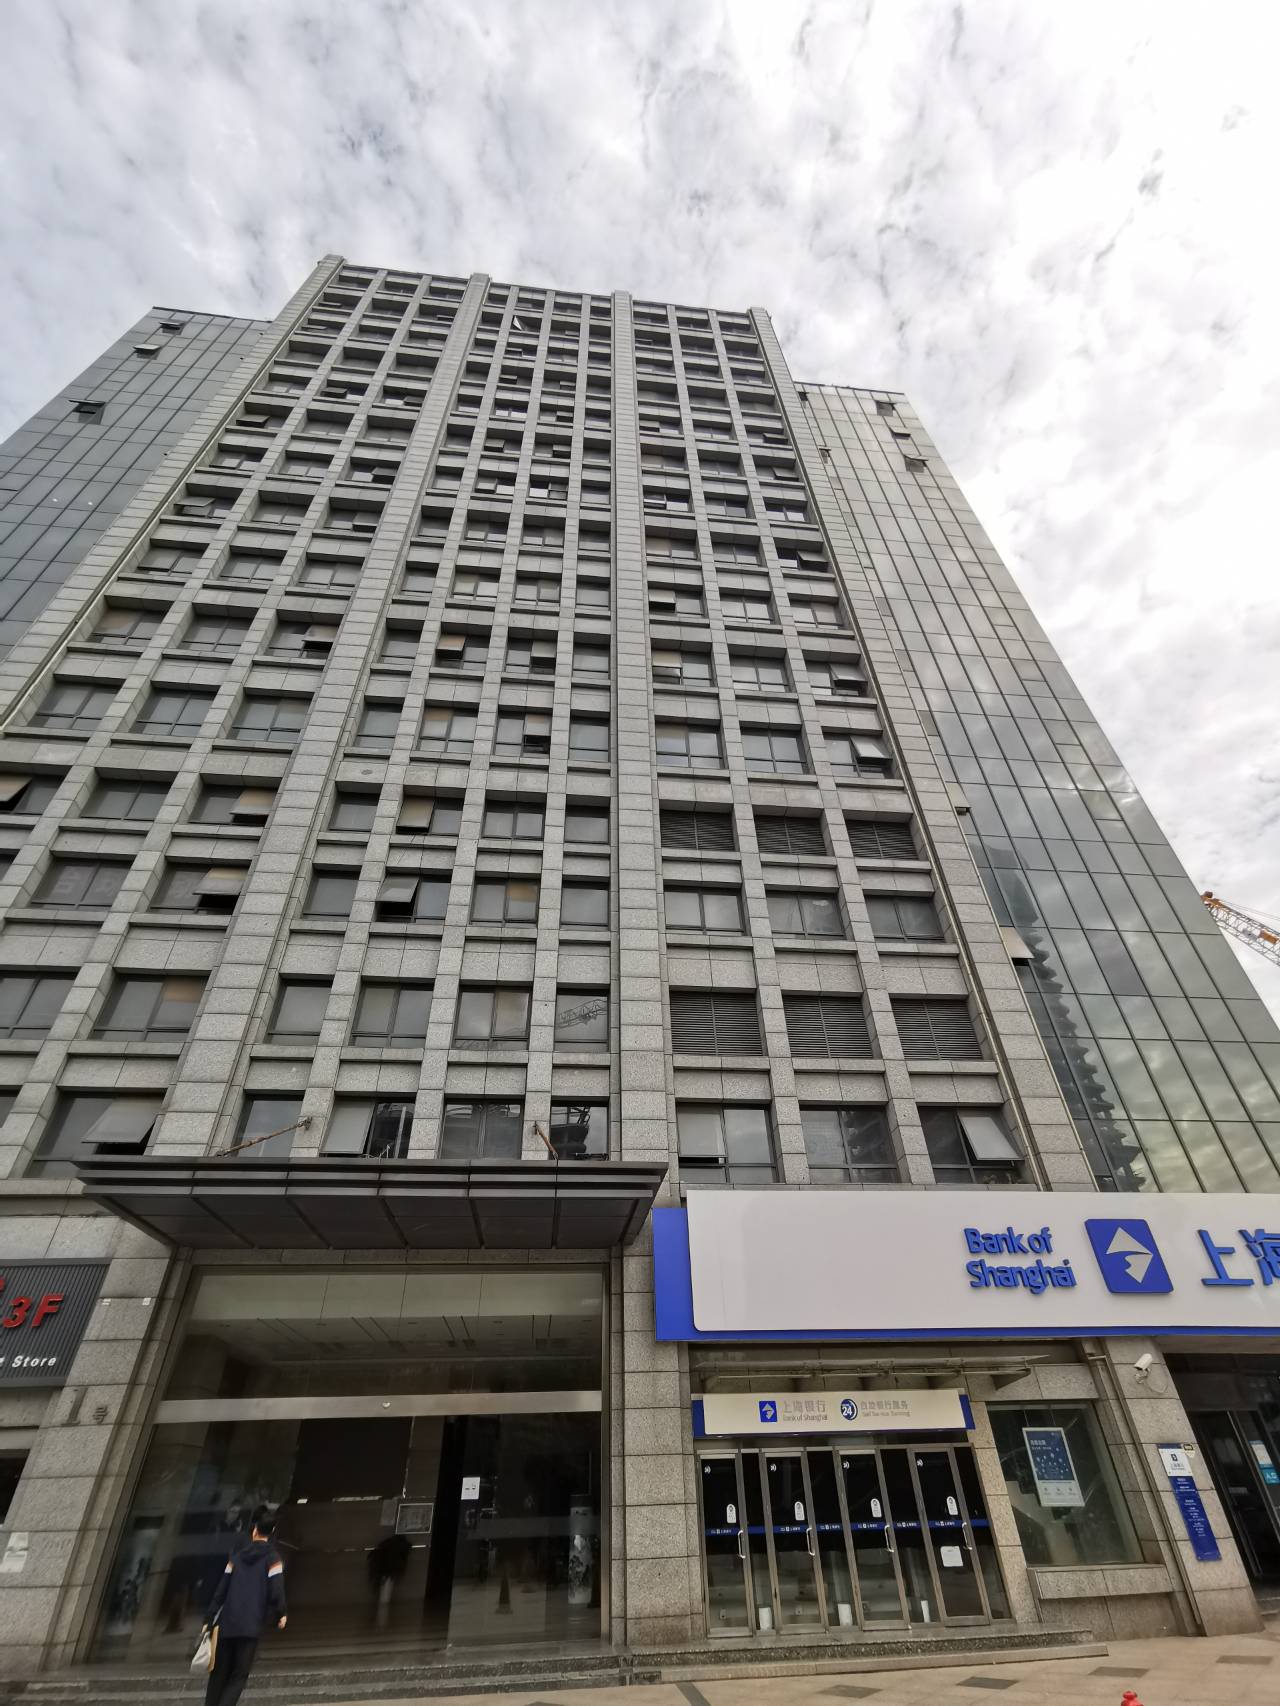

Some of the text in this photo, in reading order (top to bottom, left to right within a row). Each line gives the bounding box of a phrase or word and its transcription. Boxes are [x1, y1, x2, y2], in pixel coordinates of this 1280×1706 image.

[964, 1226, 1053, 1254] Bank of
[966, 1259, 1078, 1294] Shanghai
[3, 1293, 64, 1328] 3F
[12, 1355, 56, 1367] Store
[842, 1405, 853, 1417] 24
